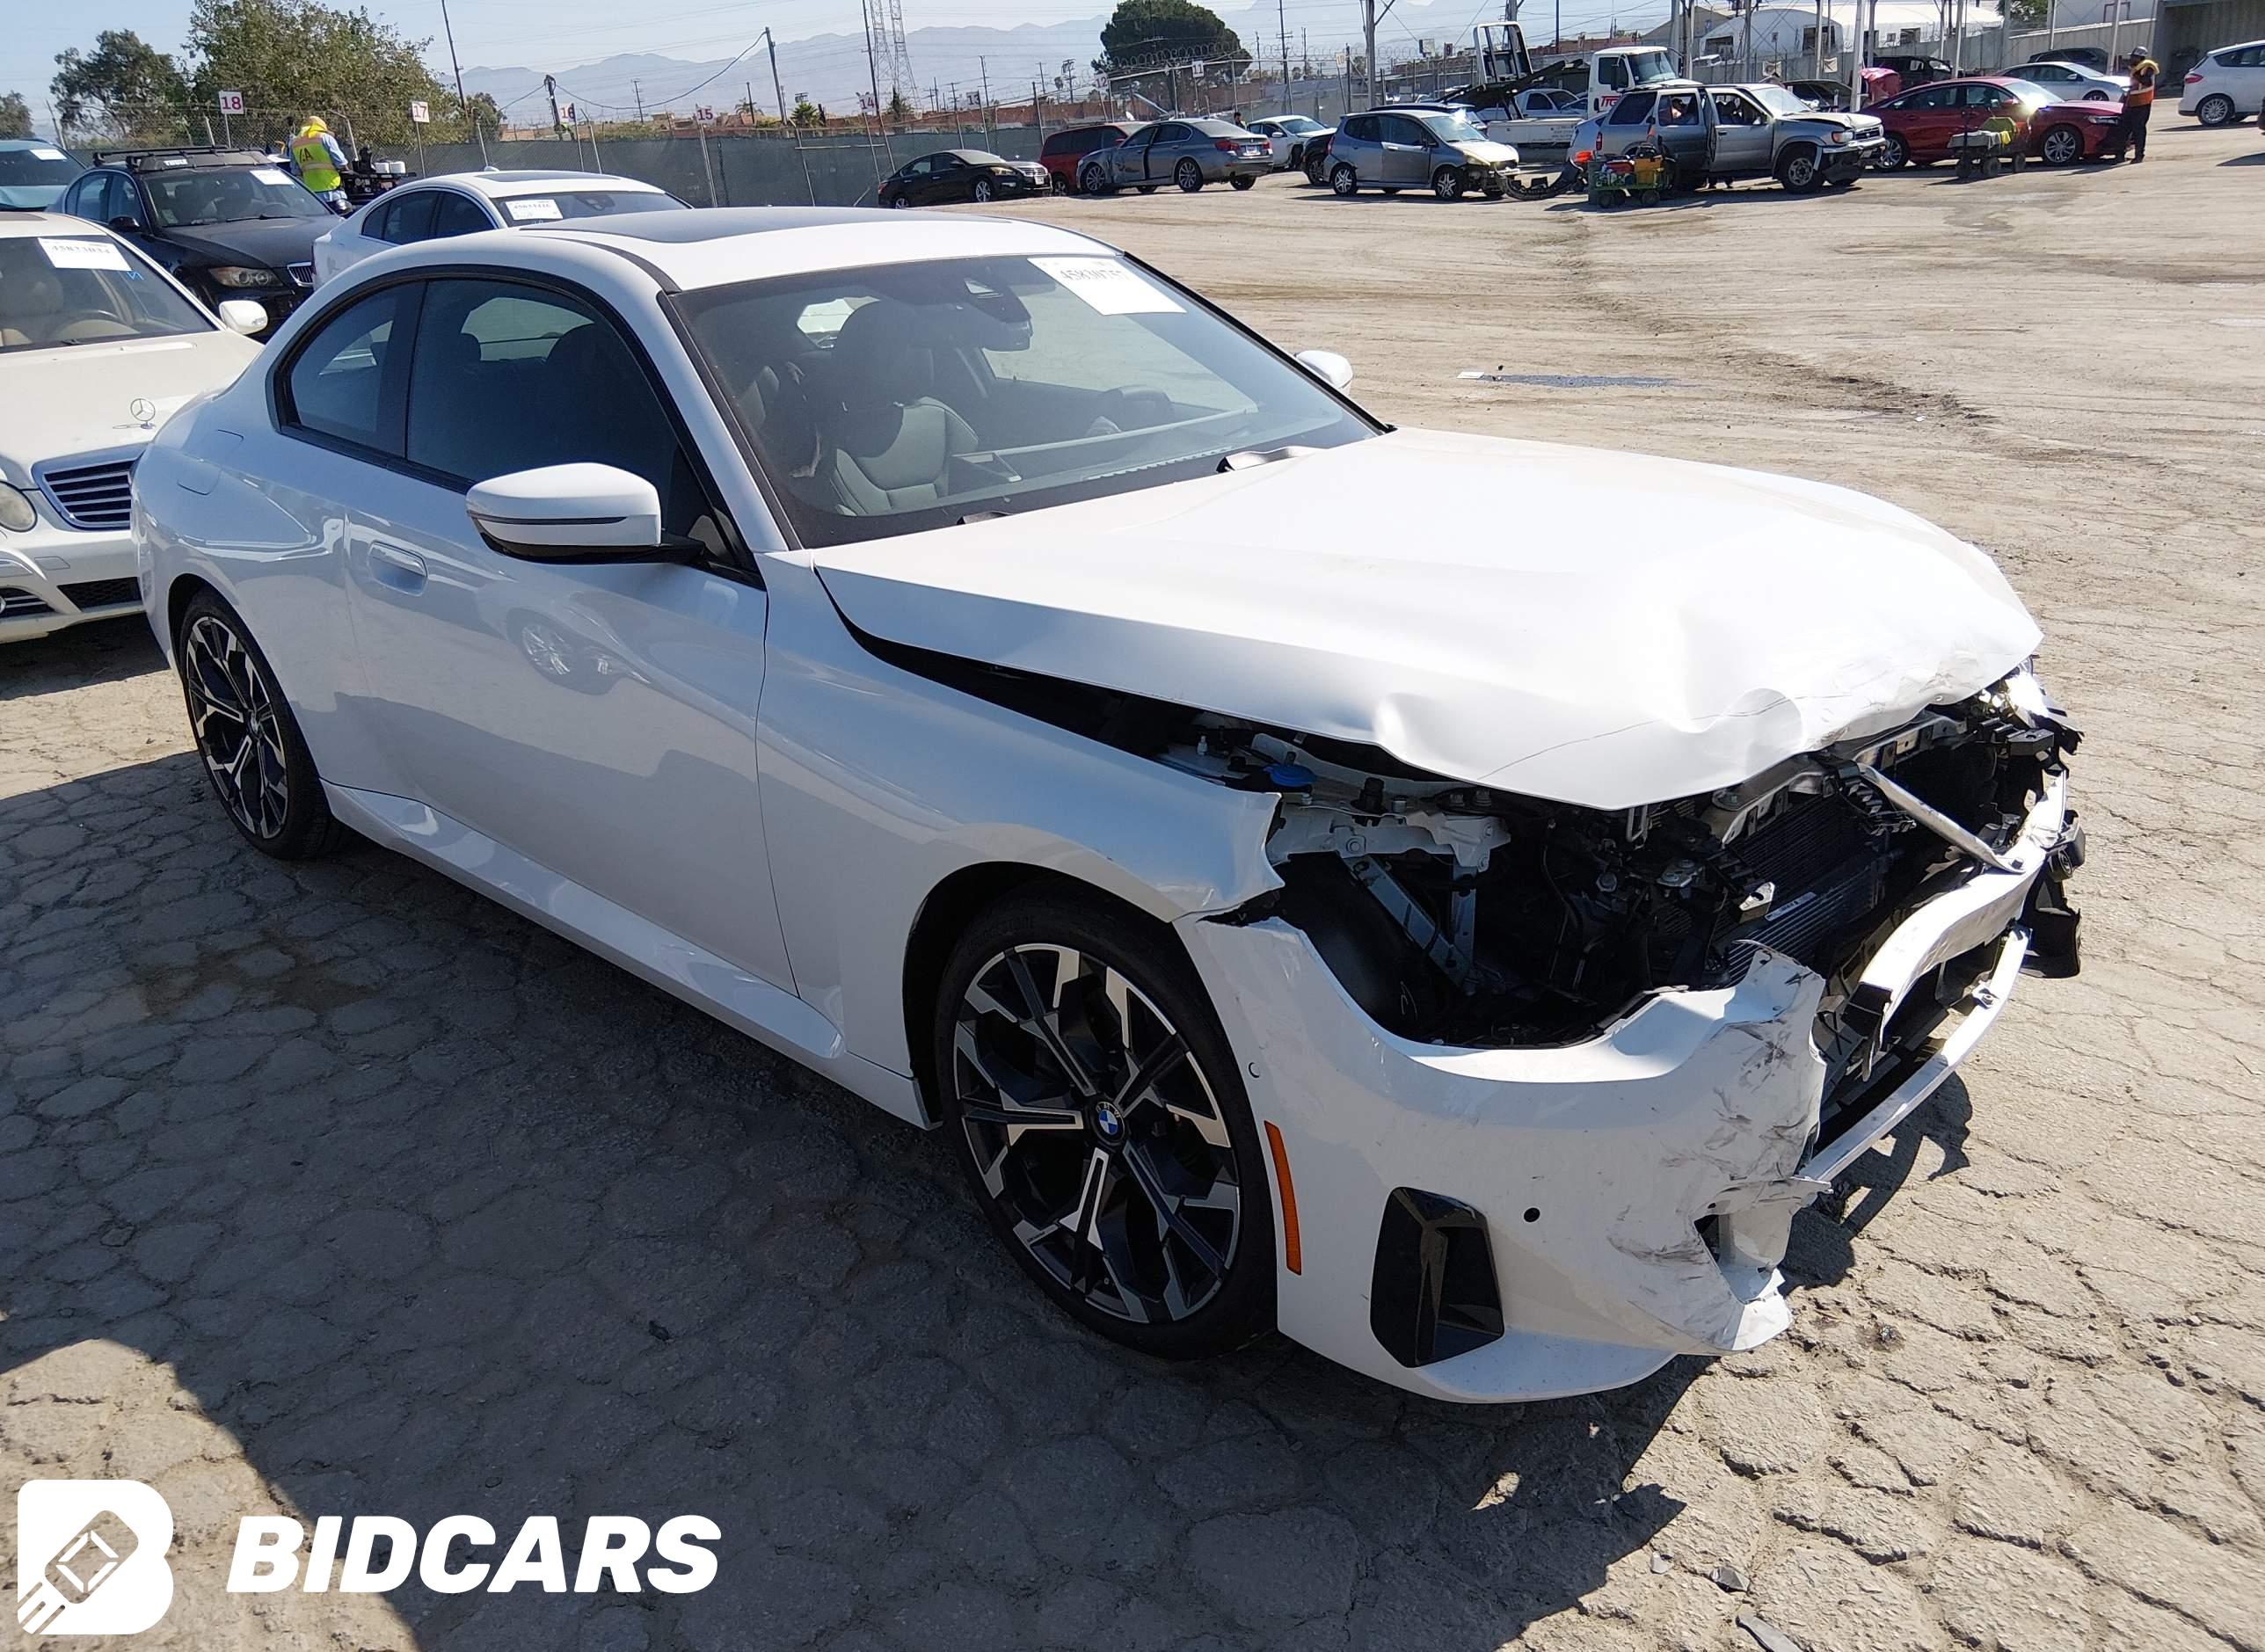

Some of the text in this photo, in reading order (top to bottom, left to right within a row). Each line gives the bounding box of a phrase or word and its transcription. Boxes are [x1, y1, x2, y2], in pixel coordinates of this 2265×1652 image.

[1192, 63, 1204, 75] 11
[1096, 76, 1108, 89] 12
[221, 96, 243, 110] 18
[860, 97, 875, 110] 14
[966, 93, 980, 106] 13
[412, 105, 428, 119] 17
[561, 106, 576, 120] 16
[697, 107, 714, 121] 15
[1095, 1102, 1121, 1118] BMW
